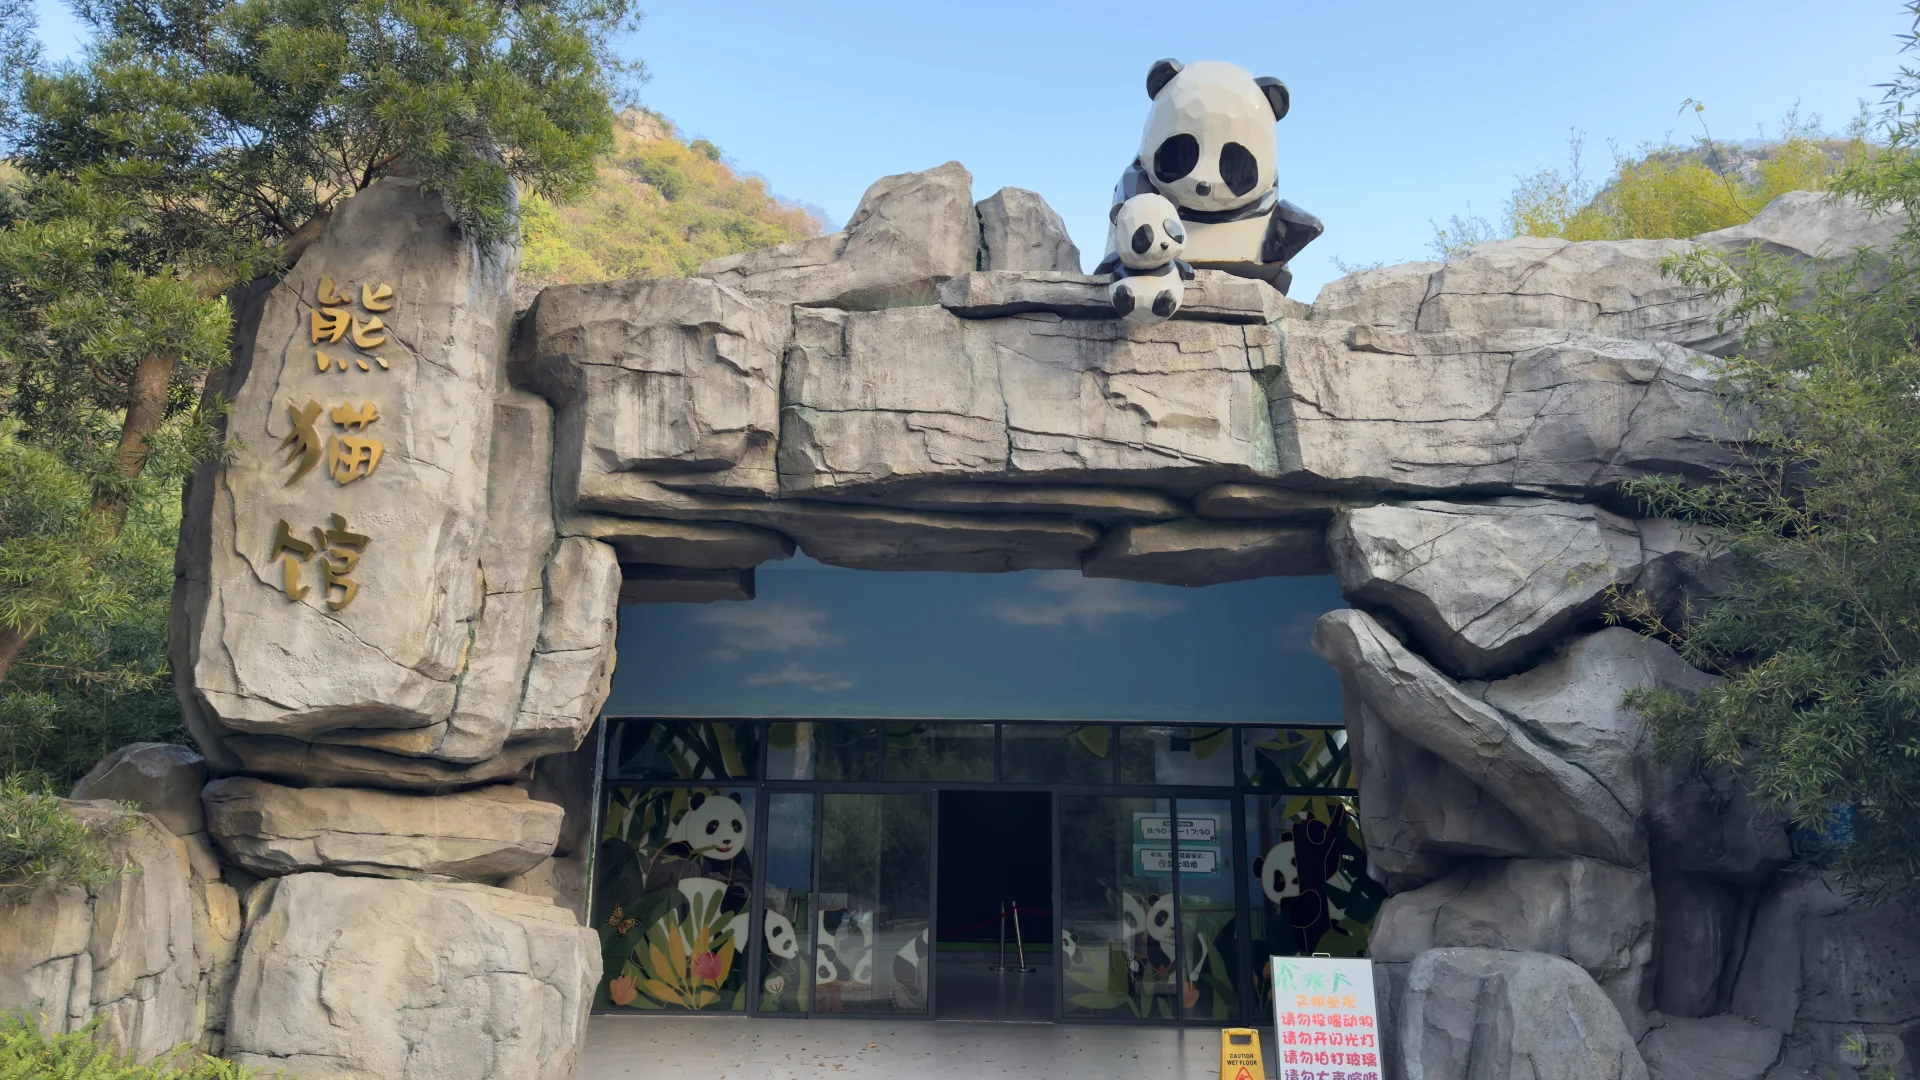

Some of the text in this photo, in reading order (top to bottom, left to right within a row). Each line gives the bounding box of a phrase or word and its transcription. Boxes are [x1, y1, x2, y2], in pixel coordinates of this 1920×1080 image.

[269, 273, 393, 612] 熊猫馆
[1296, 994, 1357, 1009] 文明参观
[1281, 1012, 1374, 1029] 请勿投喂动物
[1282, 1031, 1375, 1048] 请勿开闪光灯
[1283, 1050, 1378, 1067] 请勿拍打玻璃
